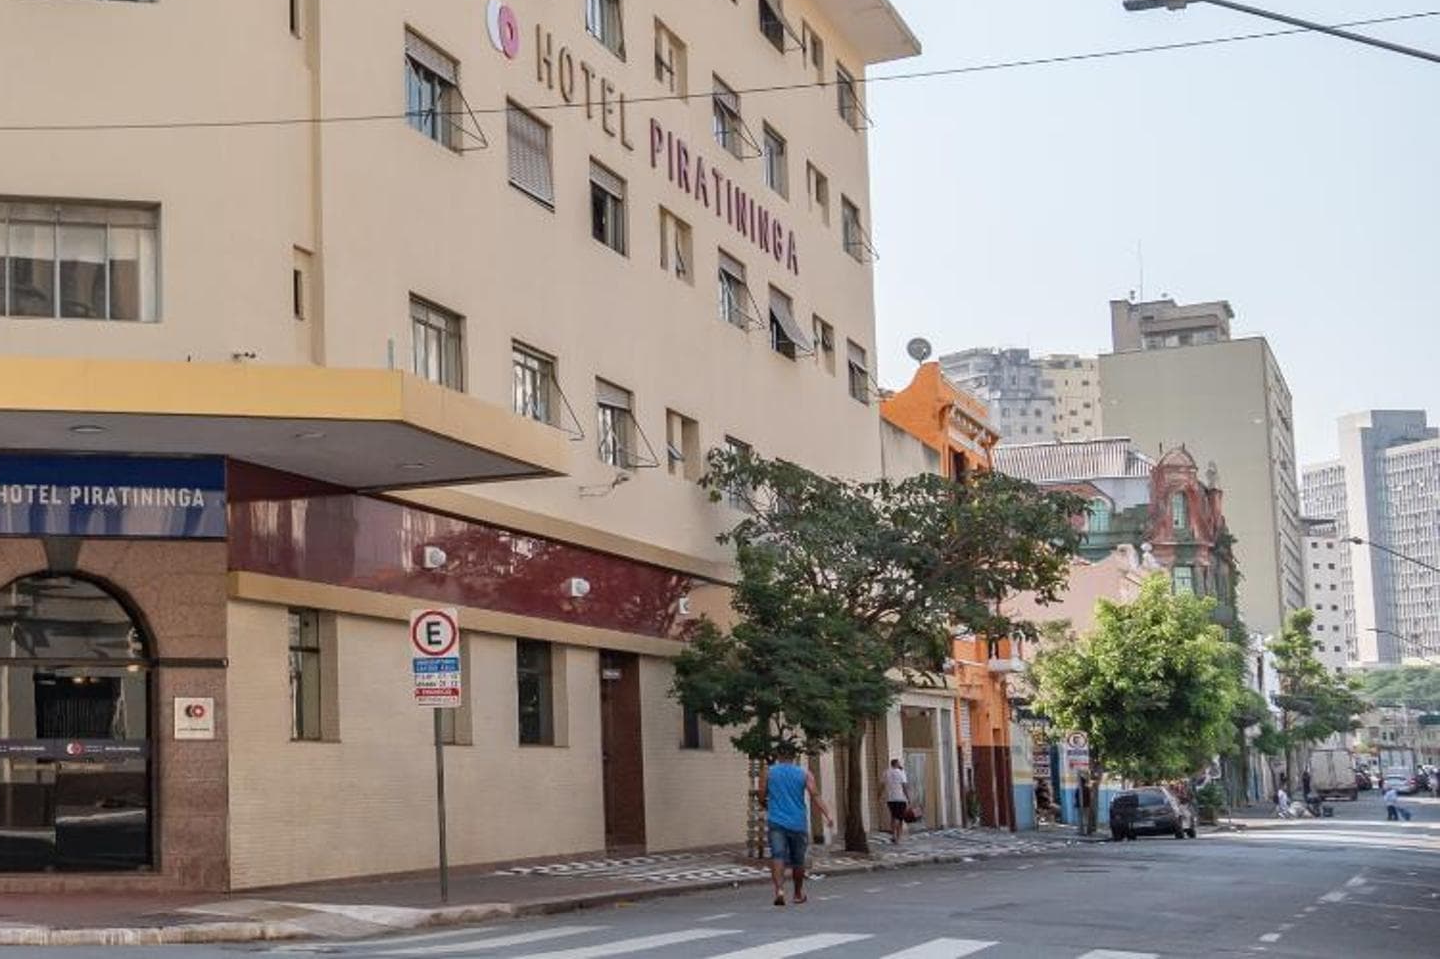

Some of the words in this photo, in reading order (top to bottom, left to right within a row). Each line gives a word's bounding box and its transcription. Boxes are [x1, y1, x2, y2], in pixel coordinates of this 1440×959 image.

[536, 23, 634, 151] HOTEL
[650, 117, 800, 276] PIRATININGA
[70, 486, 205, 507] PIRATININGA
[426, 621, 442, 646] E
